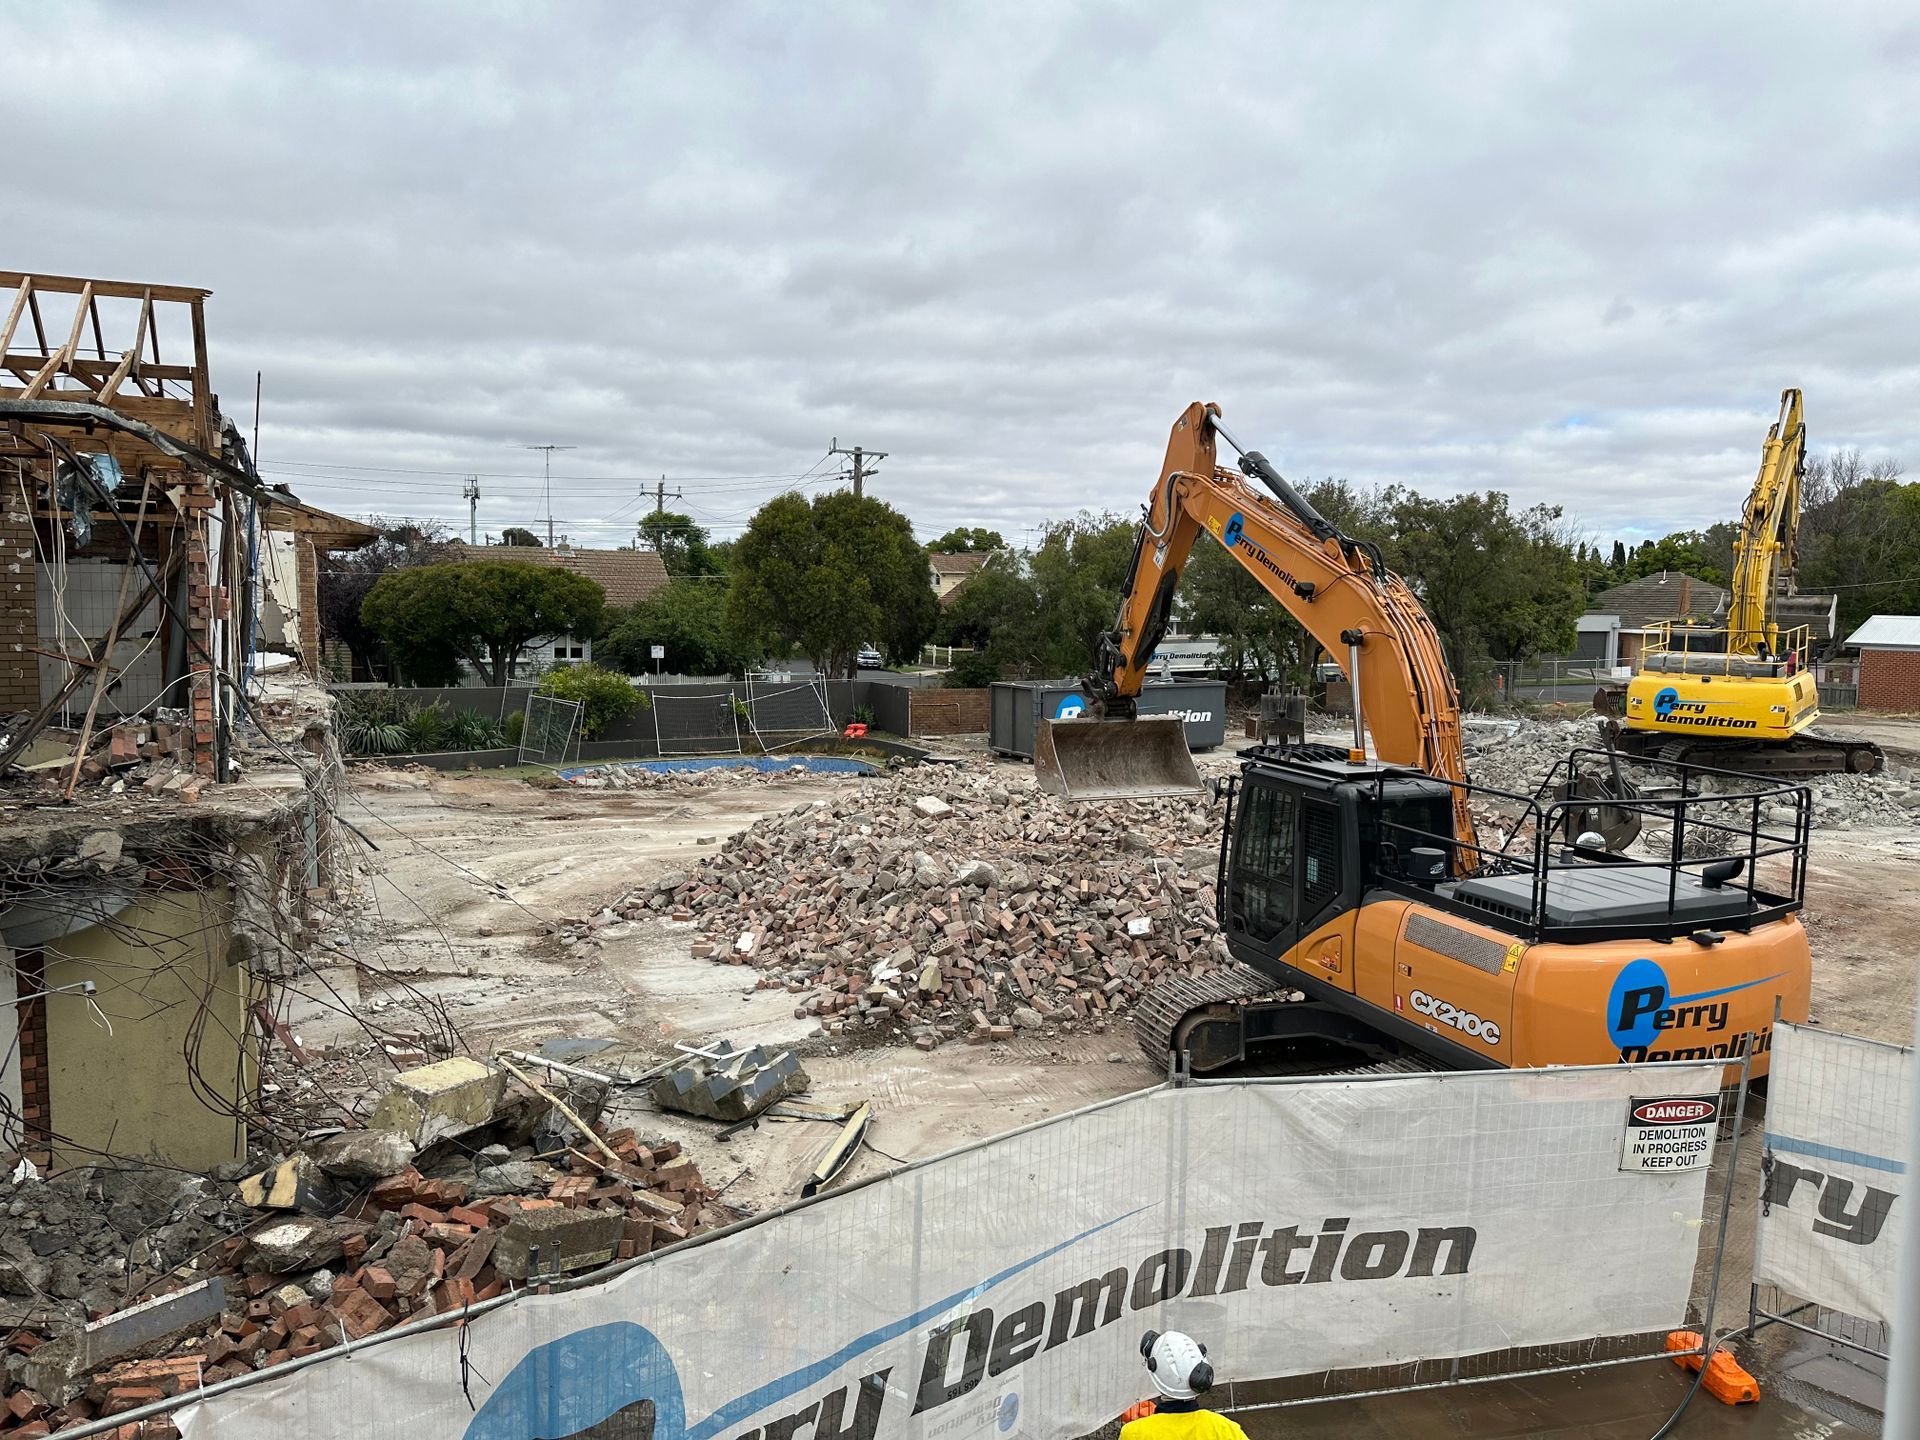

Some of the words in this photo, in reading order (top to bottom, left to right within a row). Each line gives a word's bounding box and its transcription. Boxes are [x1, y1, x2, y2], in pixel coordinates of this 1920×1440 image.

[1227, 520, 1256, 557] Perry
[1256, 549, 1298, 590] Demolit
[1656, 695, 1706, 713] Perry
[1655, 713, 1757, 728] Demolition
[1409, 989, 1501, 1045] CX210C
[1616, 985, 1729, 1032] Perry
[1618, 1027, 1772, 1064] Demoliti
[1645, 1105, 1704, 1118] DANGER
[1638, 1127, 1706, 1140] DEMOLITION
[1633, 1144, 1645, 1154] IN
[1647, 1140, 1707, 1154] PROGRESS
[1641, 1157, 1673, 1168] KEEP
[1675, 1154, 1697, 1167] OUT
[910, 1218, 1477, 1417] Demolition
